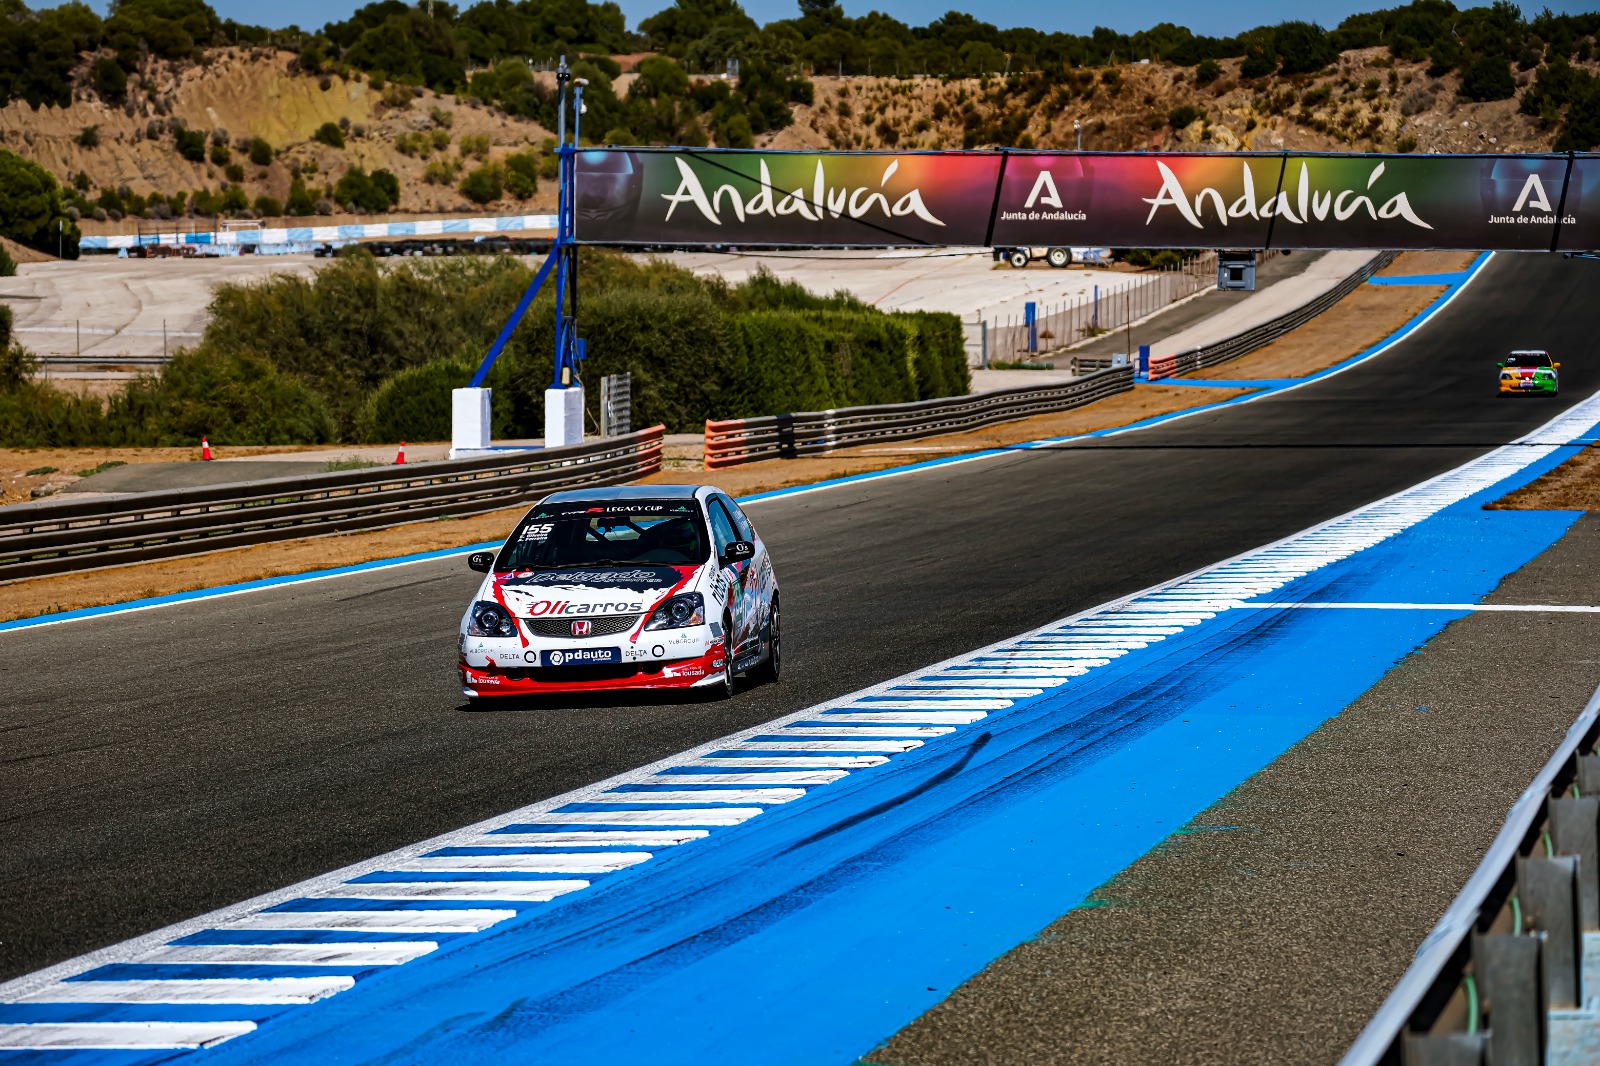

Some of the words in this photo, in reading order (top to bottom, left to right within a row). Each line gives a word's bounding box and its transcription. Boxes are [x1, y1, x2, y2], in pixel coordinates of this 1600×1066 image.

[661, 156, 947, 226] Andalucía
[1142, 159, 1434, 230] Andalucía
[1001, 210, 1026, 221] Junta
[1028, 210, 1040, 221] de
[1041, 210, 1086, 221] Andalucía
[1488, 214, 1514, 224] Junta
[1517, 214, 1528, 224] de
[606, 505, 643, 513] LEGACY
[521, 523, 555, 535] 155
[528, 600, 643, 616] Olicarros
[565, 649, 612, 662] pdauto
[625, 649, 648, 657] DELTA
